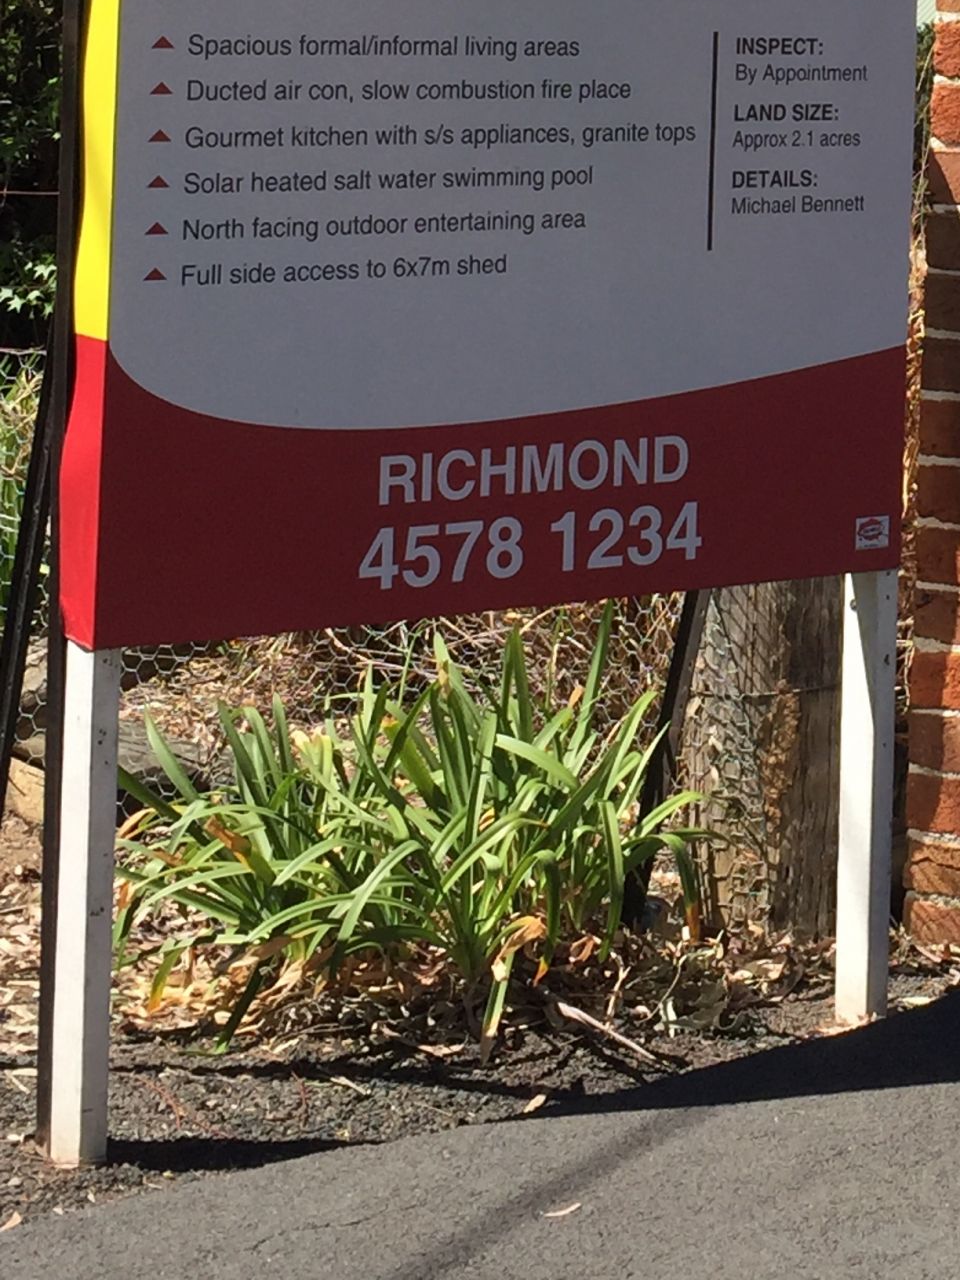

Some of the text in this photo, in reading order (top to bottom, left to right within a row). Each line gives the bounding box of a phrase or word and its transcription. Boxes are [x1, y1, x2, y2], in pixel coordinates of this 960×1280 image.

[187, 33, 581, 61] Spacious formal/informal living areas
[735, 37, 825, 56] INSPECT:
[734, 63, 869, 85] By Appointment
[185, 78, 632, 105] Ducted air con, slow combustion fire place
[732, 103, 840, 122] LAND SIZE:
[184, 121, 697, 150] Gourmet kitchen with s/s appliances, granite tops
[731, 130, 862, 152] Approx 2.1 acres
[183, 166, 594, 195] Solar heated salt water swimming pool
[731, 169, 819, 189] DETAILS:
[730, 194, 865, 216] Michael Bennett
[181, 210, 587, 243] North facing outdoor entertaining area
[180, 253, 508, 287] Full side access to 6x7m shed
[377, 434, 690, 507] RICHMOND
[357, 500, 703, 591] 4578 1234
